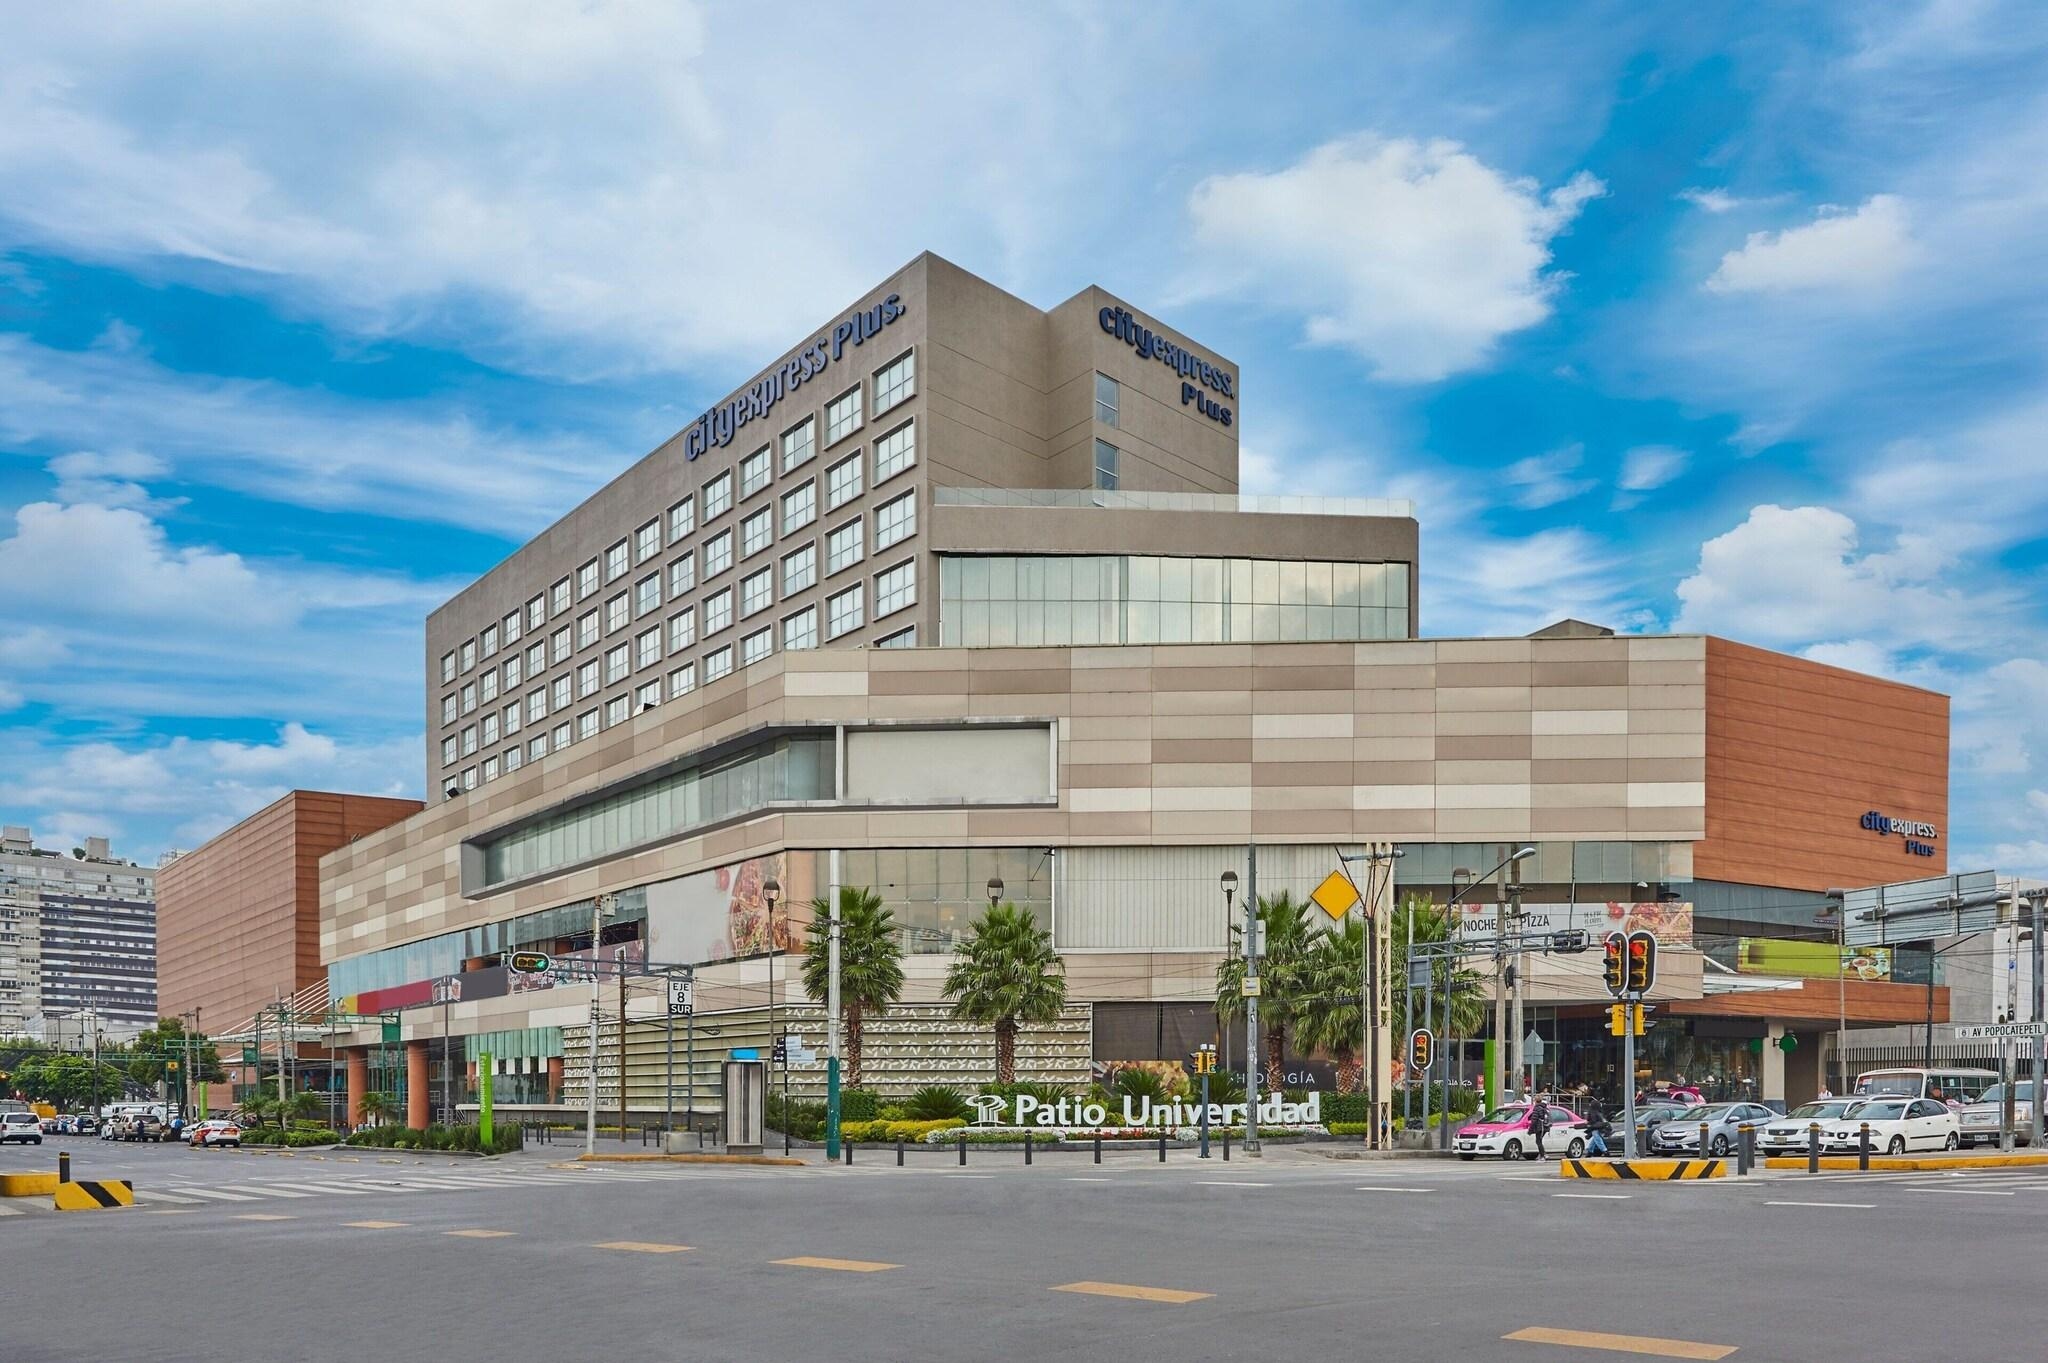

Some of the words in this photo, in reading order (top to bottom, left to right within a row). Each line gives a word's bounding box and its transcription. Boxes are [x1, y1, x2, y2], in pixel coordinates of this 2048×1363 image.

[1181, 381, 1232, 426] Plus
[1906, 839, 1935, 857] Plus
[1521, 914, 1550, 928] PIZZA
[673, 982, 690, 991] EJE
[677, 991, 685, 1003] 8
[671, 1004, 691, 1014] SUR
[1972, 1027, 1982, 1037] AV
[1985, 1024, 2044, 1036] POPOCATEPETL
[1015, 1094, 1106, 1126] Patio
